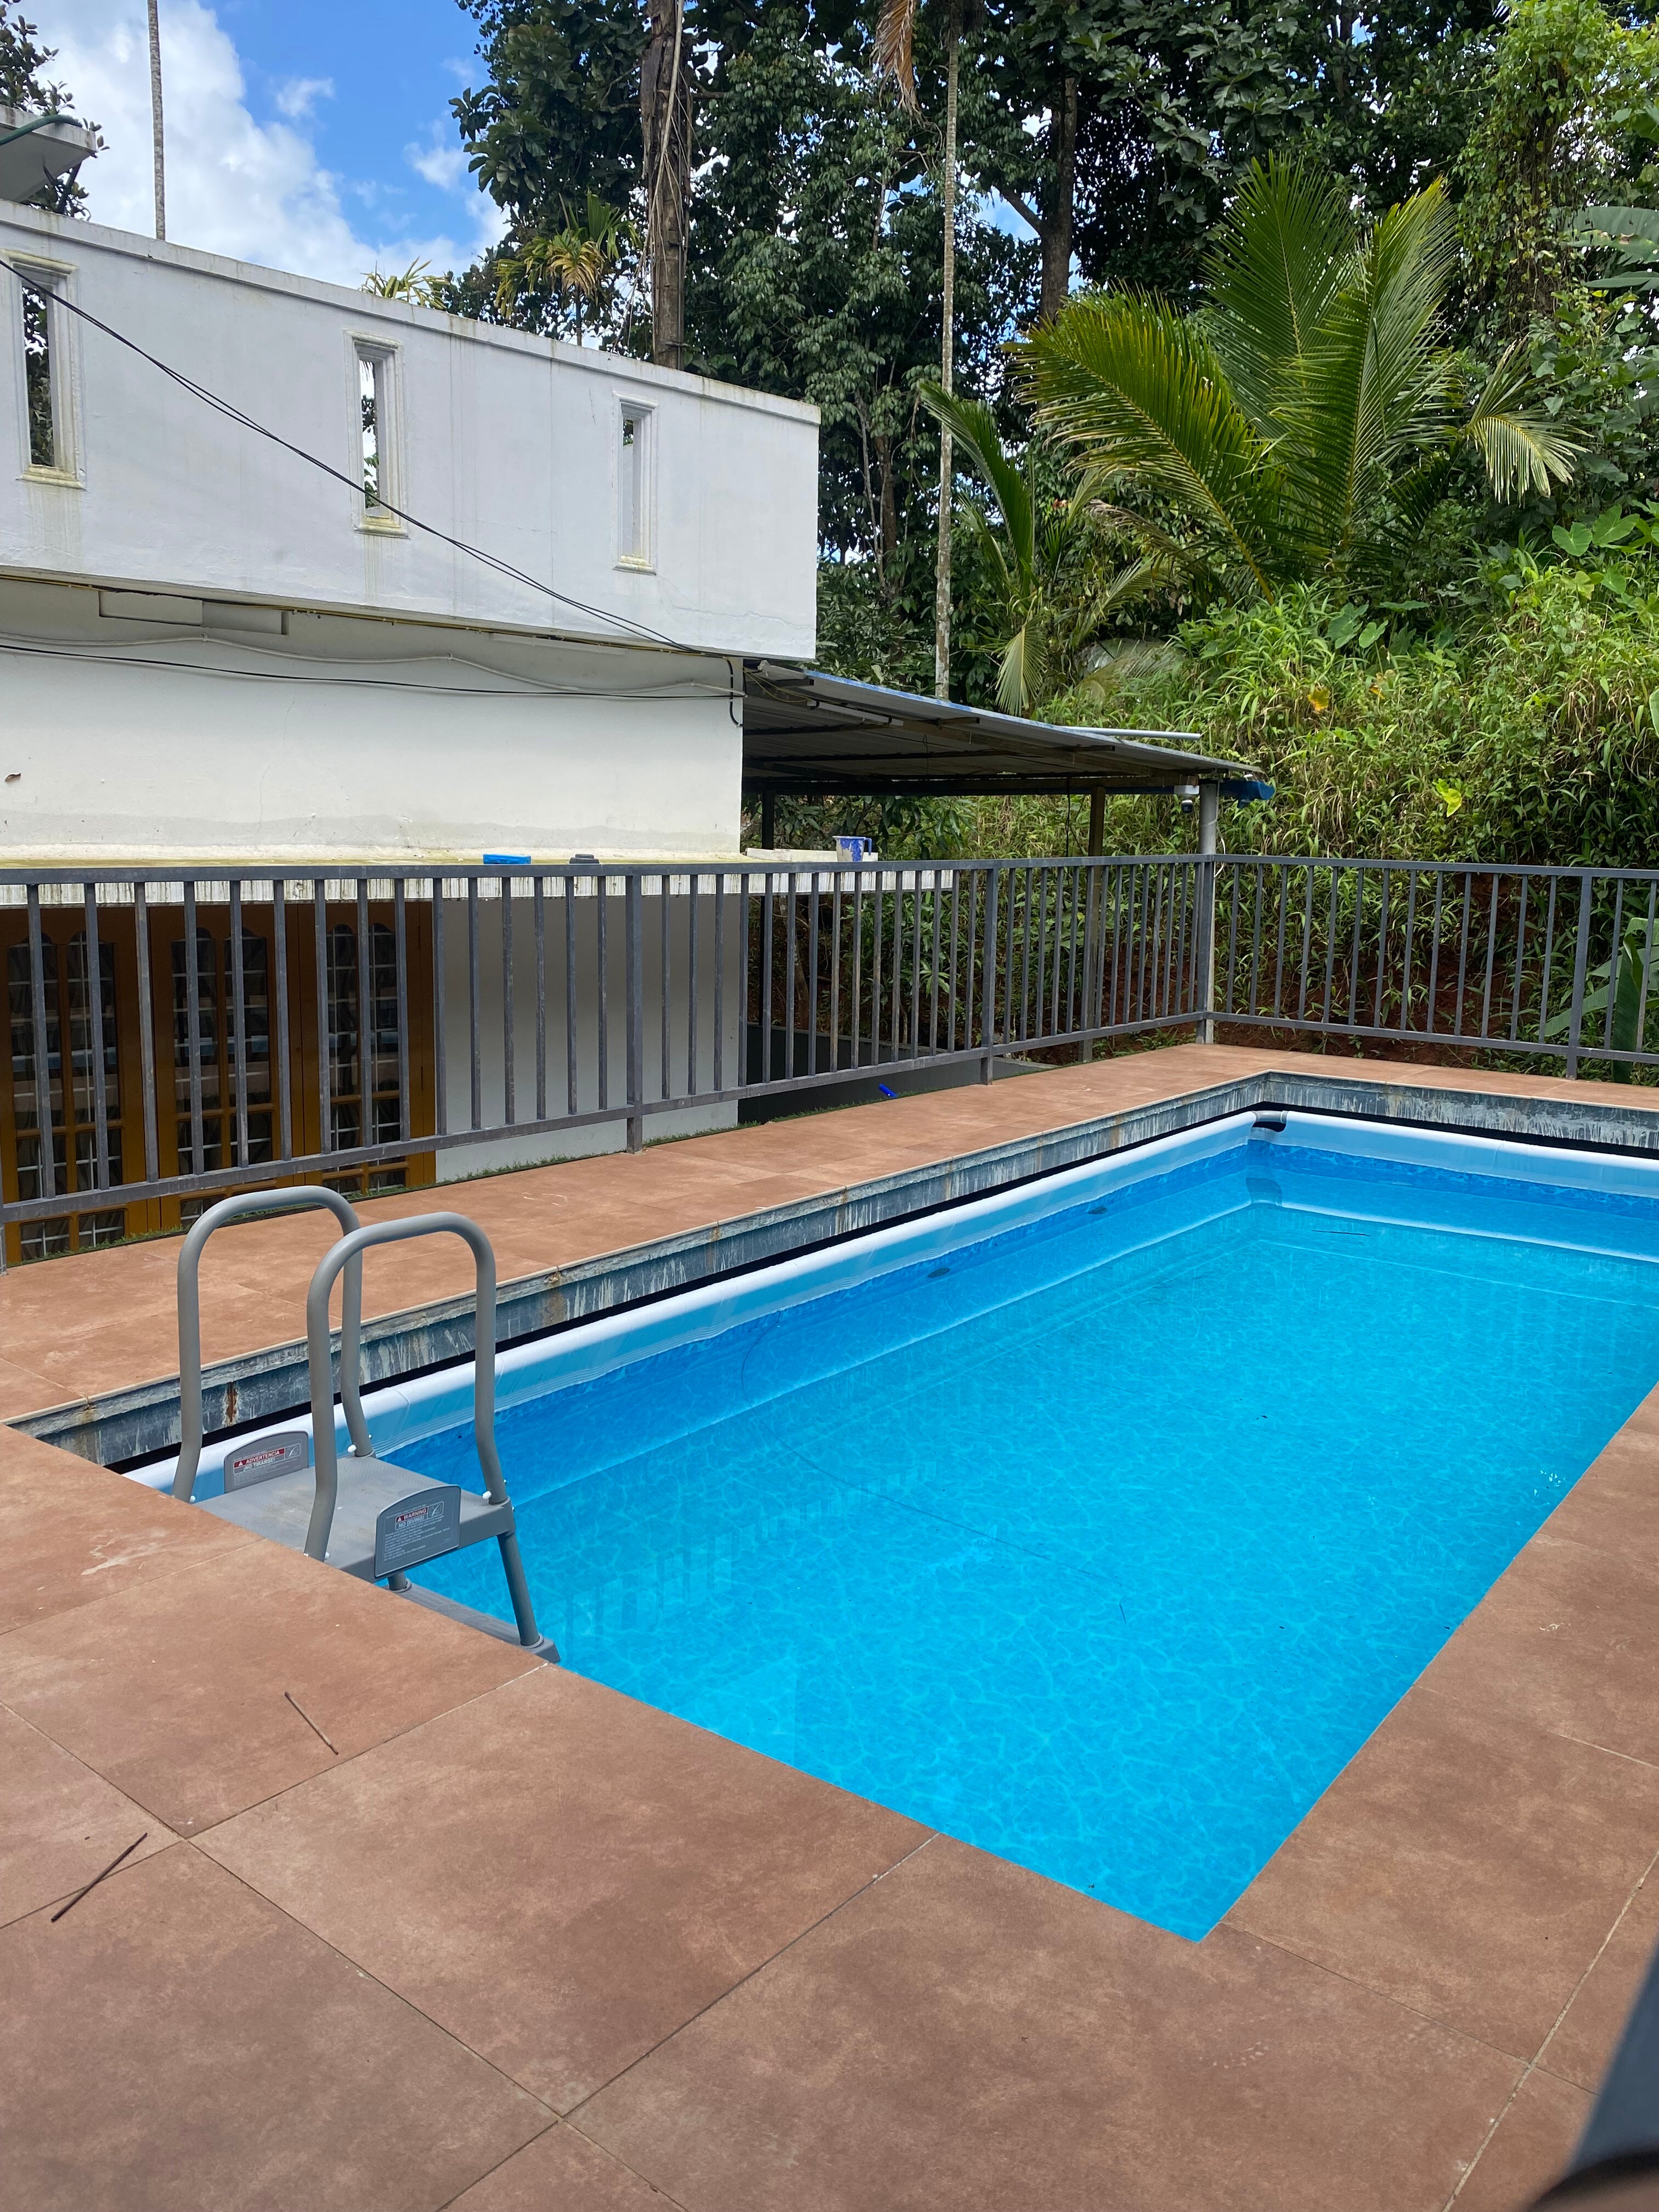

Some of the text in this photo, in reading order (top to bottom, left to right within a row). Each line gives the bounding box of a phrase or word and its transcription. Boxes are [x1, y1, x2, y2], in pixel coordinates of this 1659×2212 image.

[246, 1451, 280, 1464] ADVERTENCIA
[253, 1458, 275, 1468] TIRARSE!
[403, 1508, 427, 1520] WARNING
[407, 1515, 425, 1526] DIVING!
